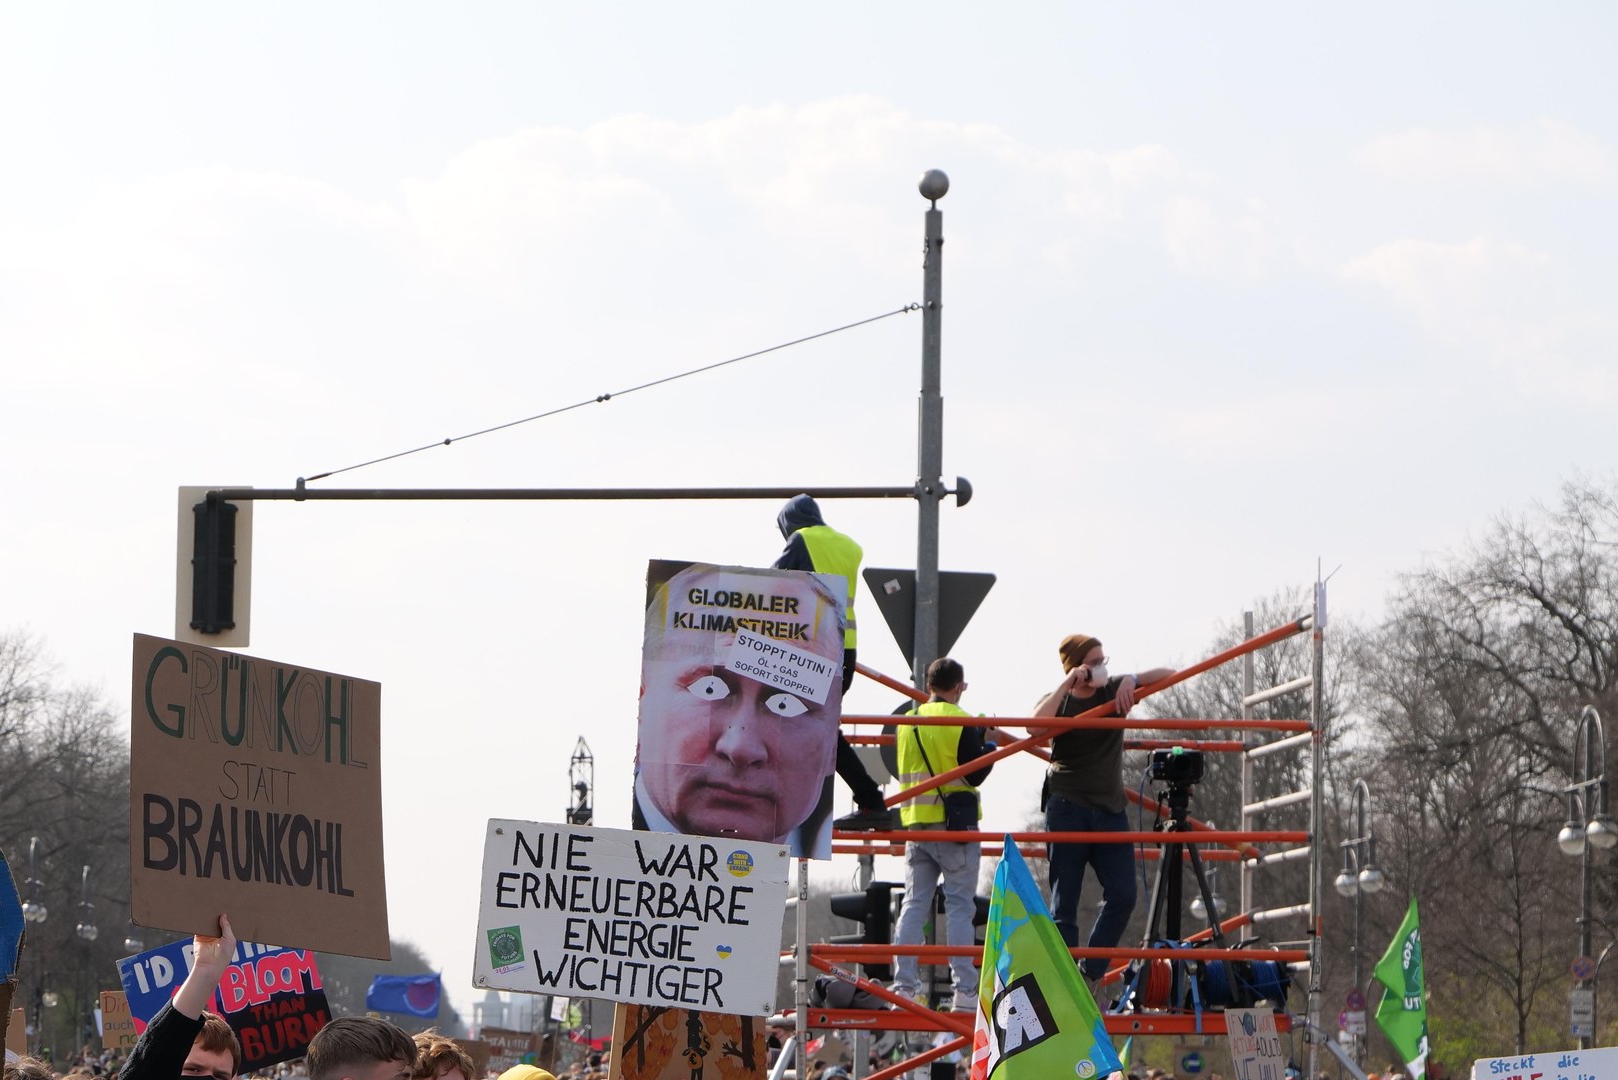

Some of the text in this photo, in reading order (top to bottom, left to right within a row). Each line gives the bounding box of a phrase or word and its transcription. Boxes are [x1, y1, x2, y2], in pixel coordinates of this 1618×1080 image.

[688, 588, 800, 615] GLOBALER
[673, 611, 810, 641] KLIMASTREIK
[738, 634, 788, 659] STOPPT
[788, 654, 826, 675] PUTIN
[757, 656, 770, 668] ÖL
[779, 665, 799, 679] GAS
[734, 660, 815, 696] SOFORT STOPPEN
[145, 646, 368, 769] GRÜNKOHL
[219, 760, 297, 806] STATT
[143, 793, 355, 898] BRAUNKOHL
[513, 831, 720, 882] NIE WAR
[496, 872, 754, 925] ERNEUERBARE
[563, 917, 699, 962] ENERGIE
[134, 955, 174, 994] I'D
[218, 949, 324, 1014] BLOOM
[533, 949, 724, 1008] WICHTIGER
[252, 996, 307, 1024] THAN
[240, 1009, 327, 1062] BURN
[1490, 1055, 1580, 1074] Steckt die
